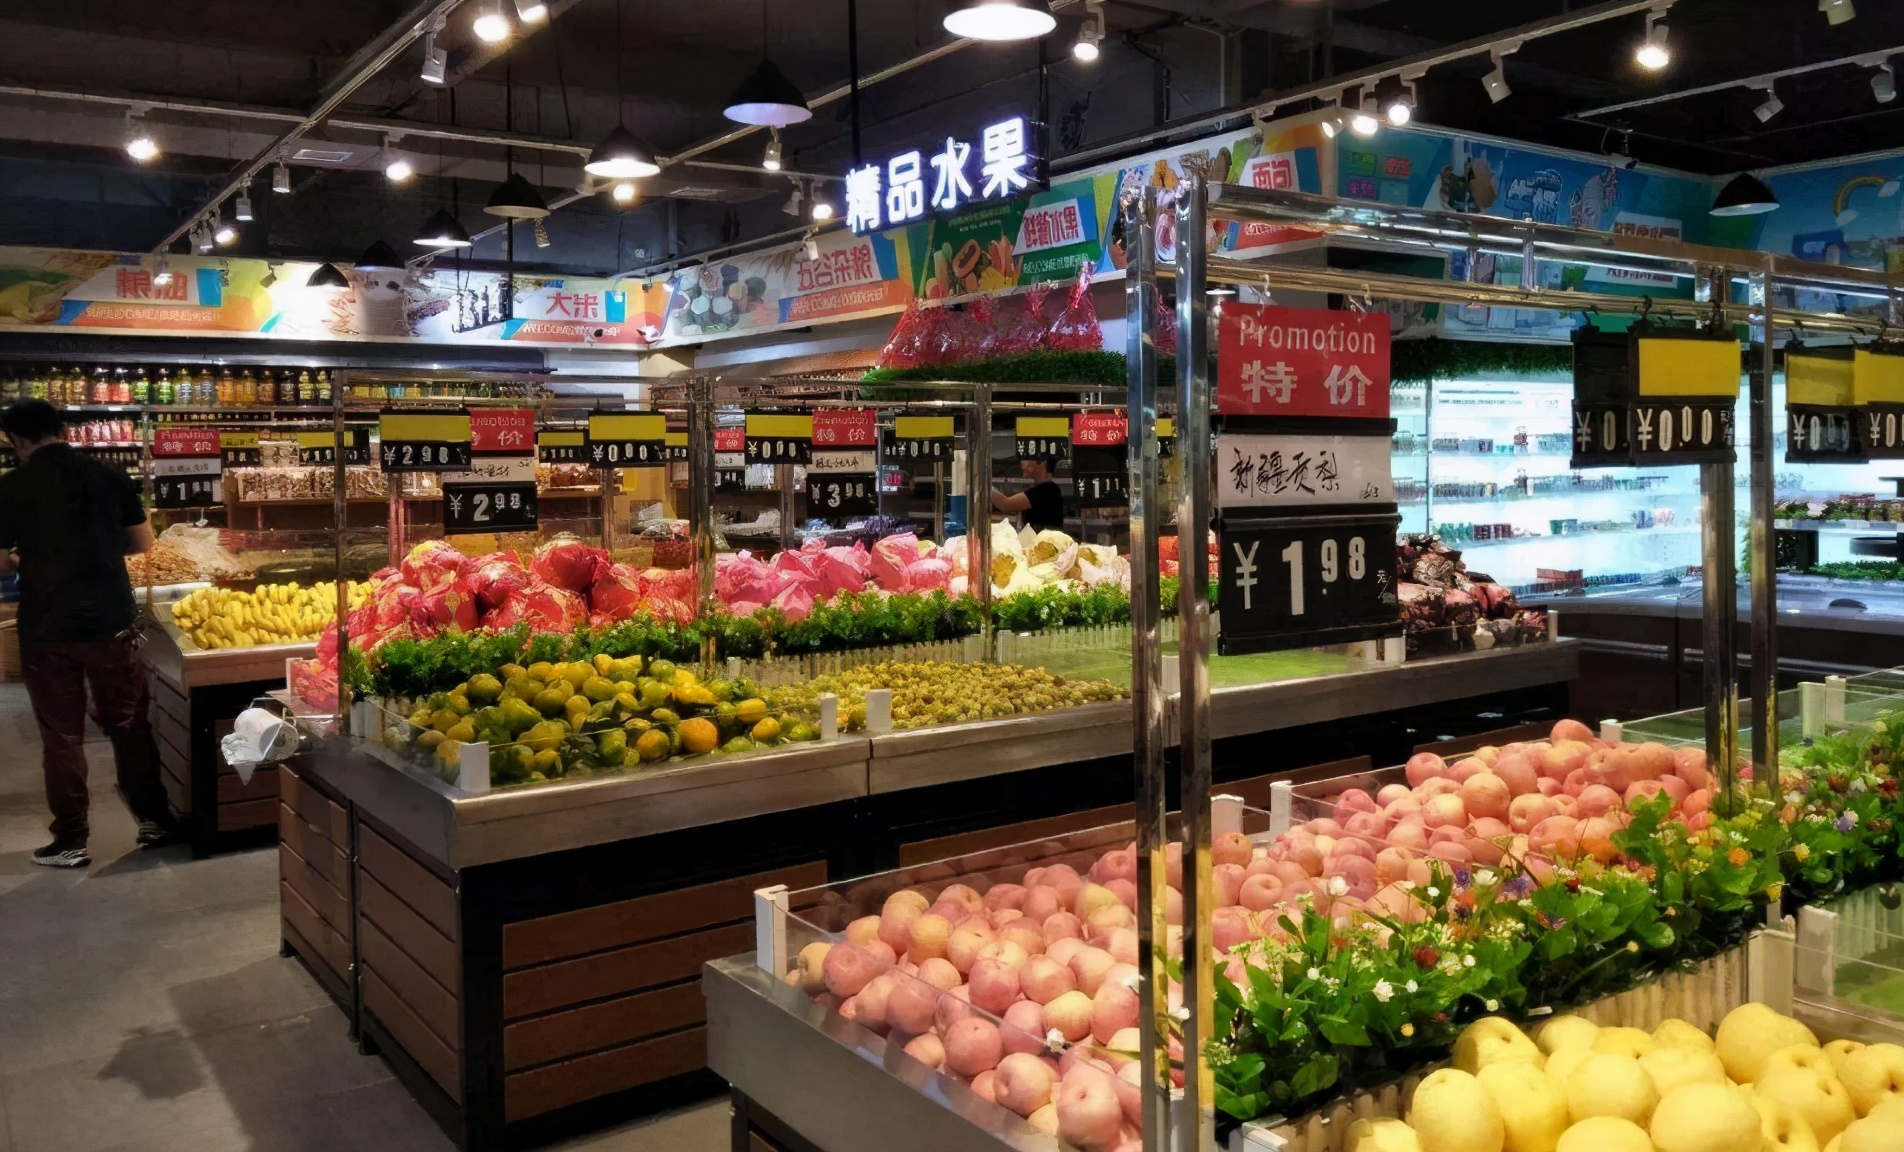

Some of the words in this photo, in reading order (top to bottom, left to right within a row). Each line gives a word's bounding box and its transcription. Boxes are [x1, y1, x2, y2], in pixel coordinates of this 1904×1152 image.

[845, 116, 1028, 233] 精品水果
[546, 292, 599, 318] 大米
[1240, 321, 1376, 354] Promotion
[1637, 405, 1714, 452] ¥0.00
